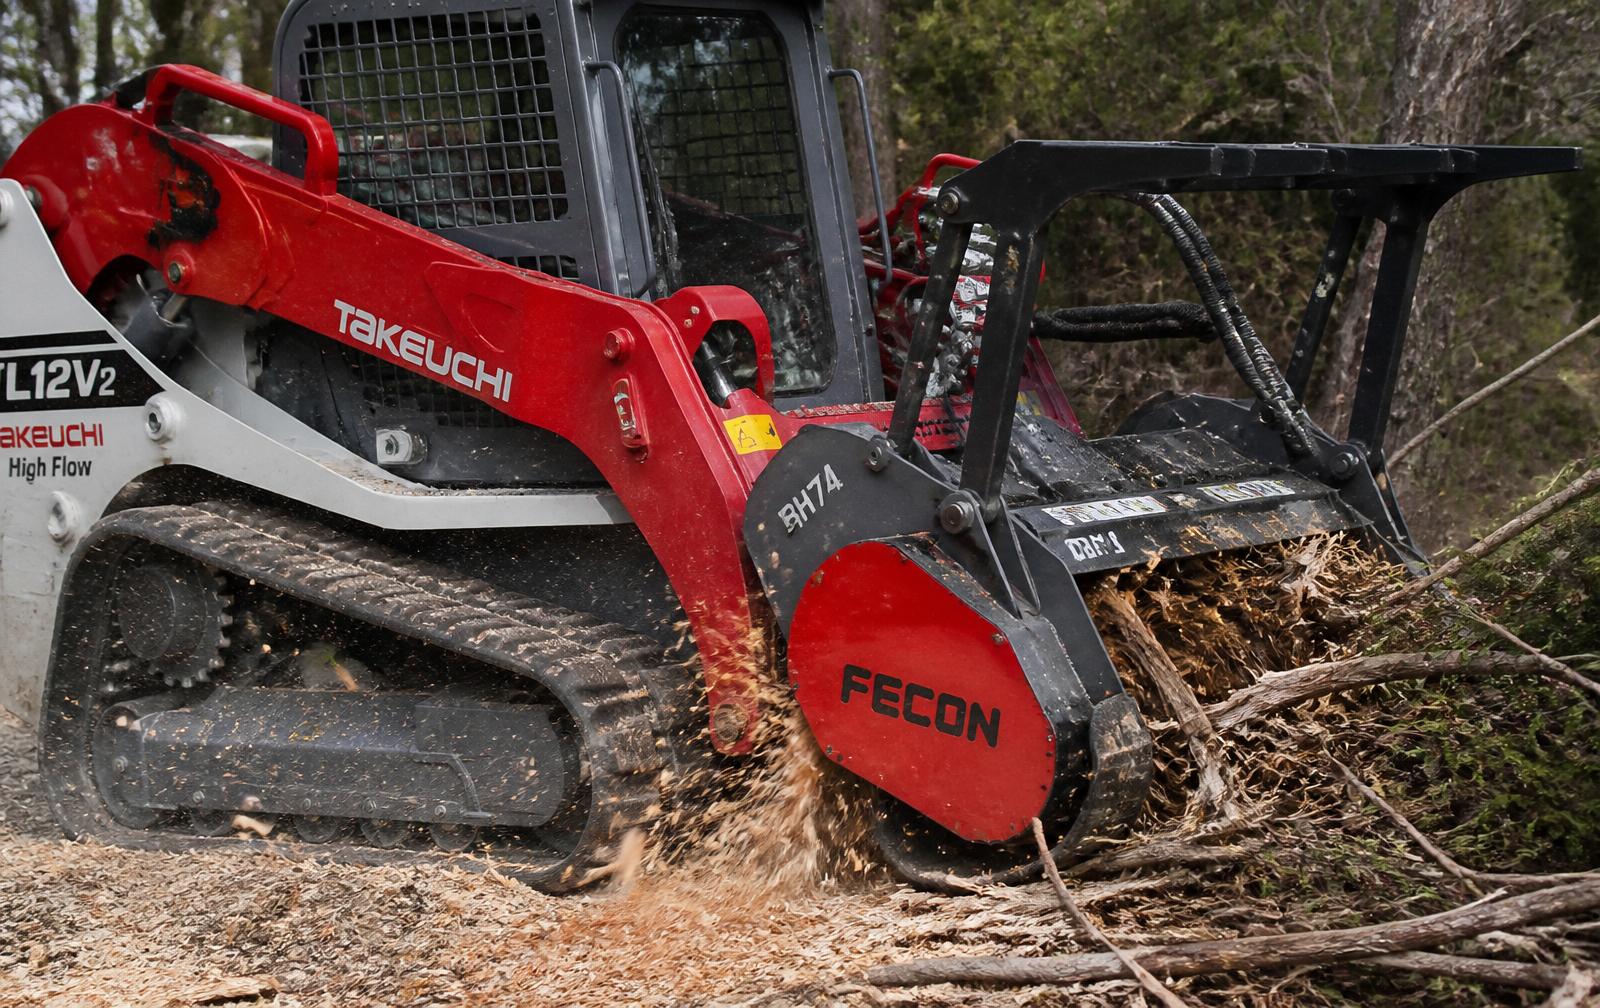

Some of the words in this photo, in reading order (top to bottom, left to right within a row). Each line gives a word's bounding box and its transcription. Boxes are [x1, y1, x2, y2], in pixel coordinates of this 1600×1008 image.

[0, 359, 117, 401] L12V2
[8, 452, 47, 484] High
[52, 455, 93, 478] Flow
[777, 463, 844, 534] BH74
[840, 663, 1001, 748] FECON
